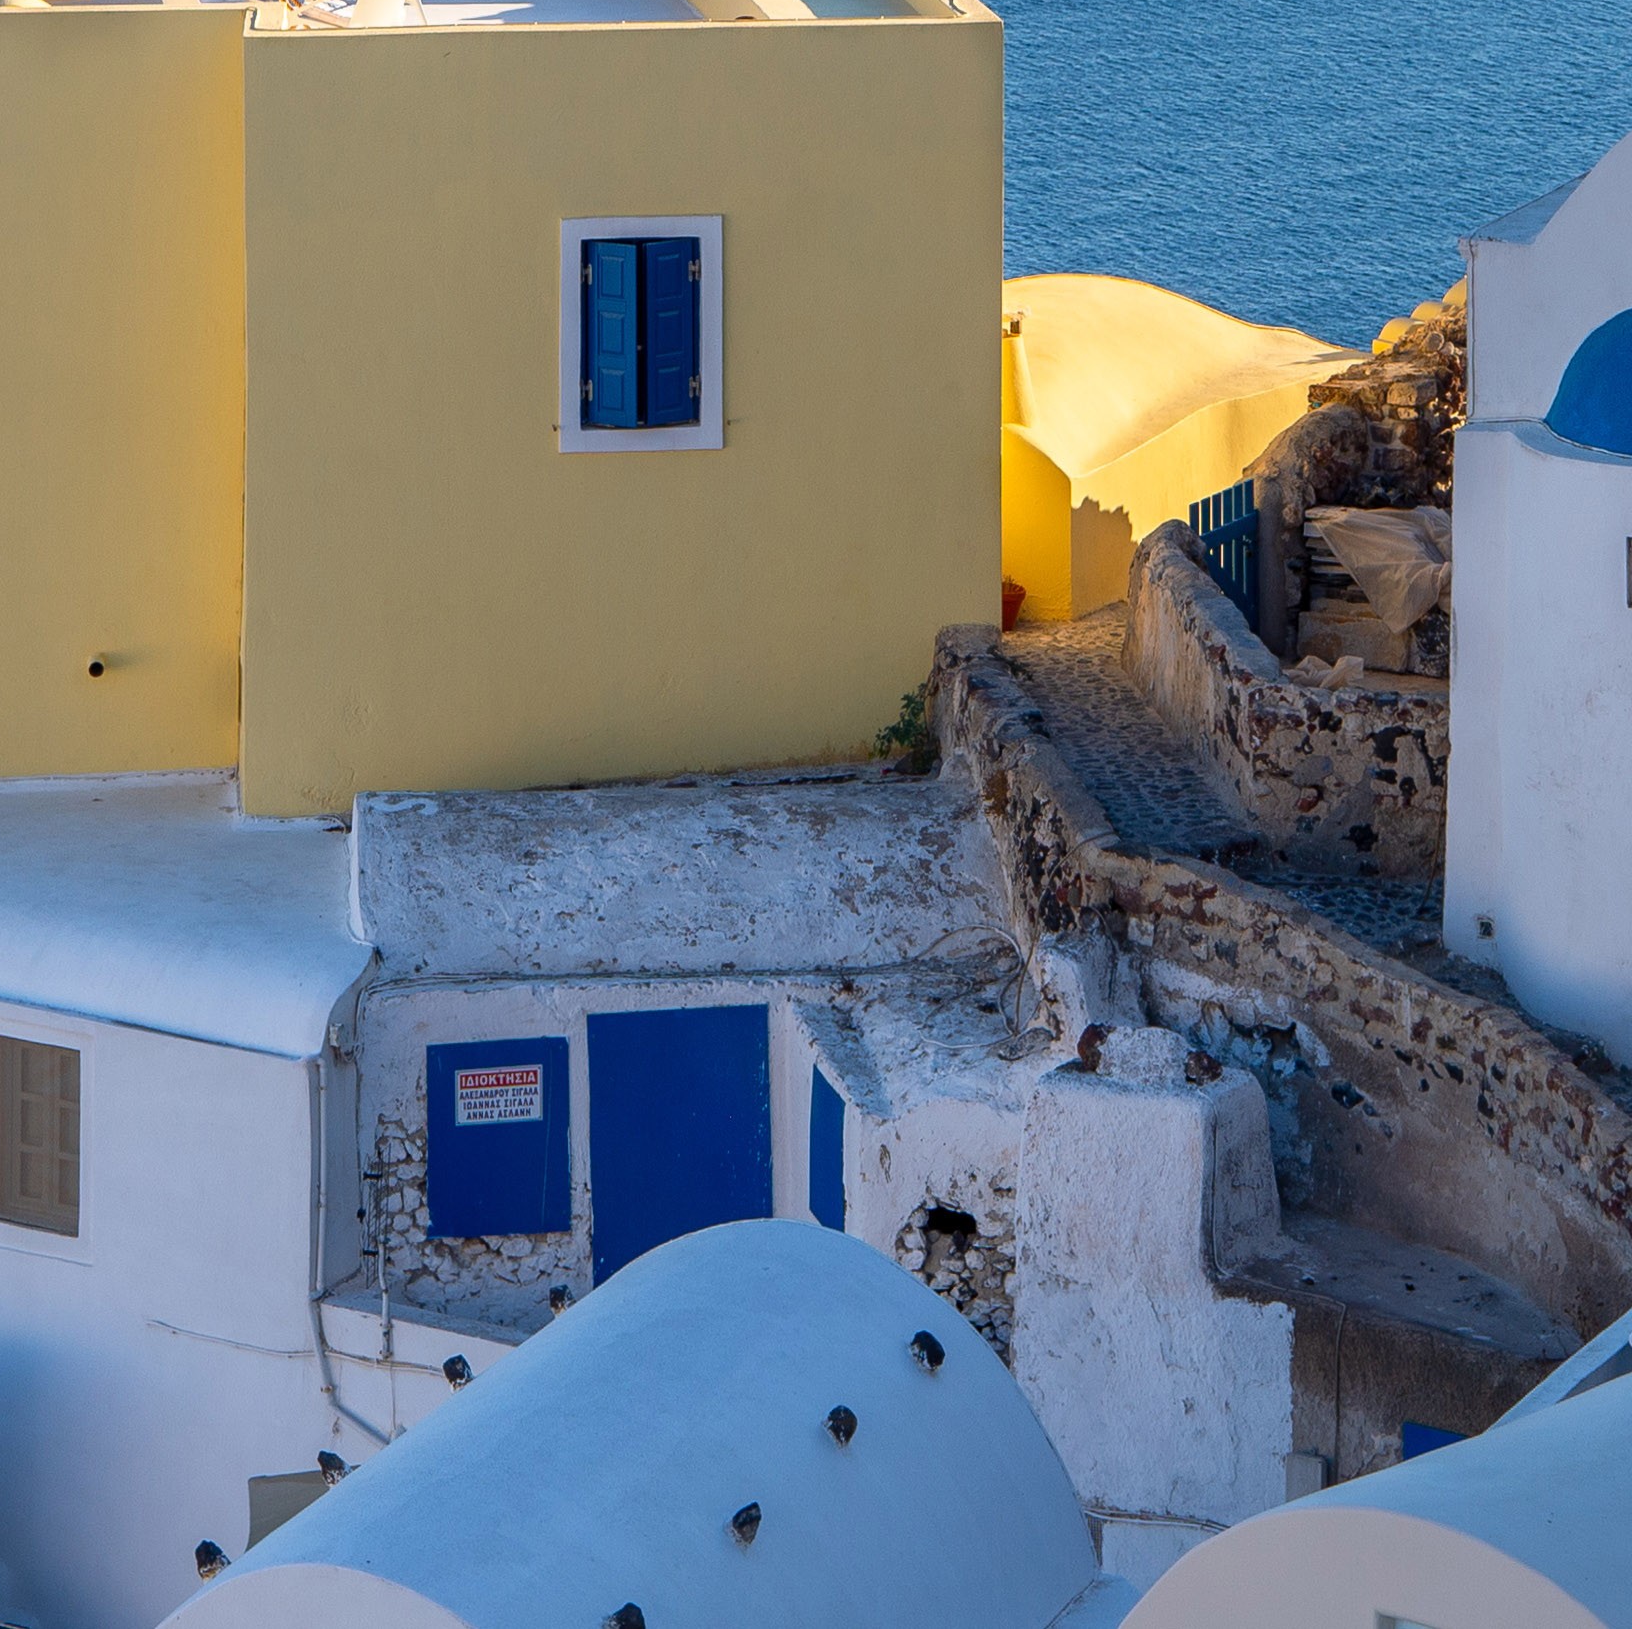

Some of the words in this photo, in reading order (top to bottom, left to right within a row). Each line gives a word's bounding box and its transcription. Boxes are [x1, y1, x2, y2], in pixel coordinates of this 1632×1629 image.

[462, 1072, 536, 1087] ΙΔΙΟΚΤΗΣΙΑ
[459, 1088, 510, 1100] ΑΛΕΞΑΝΔΡΟΥ
[512, 1087, 539, 1097] ΣΙΓΑΛΑ
[463, 1099, 501, 1110] ΙΩΑΝΝΑΣ
[504, 1098, 534, 1108] ΣΙΓΑΛΑ
[466, 1110, 495, 1120] ΑΝΝΑΣ
